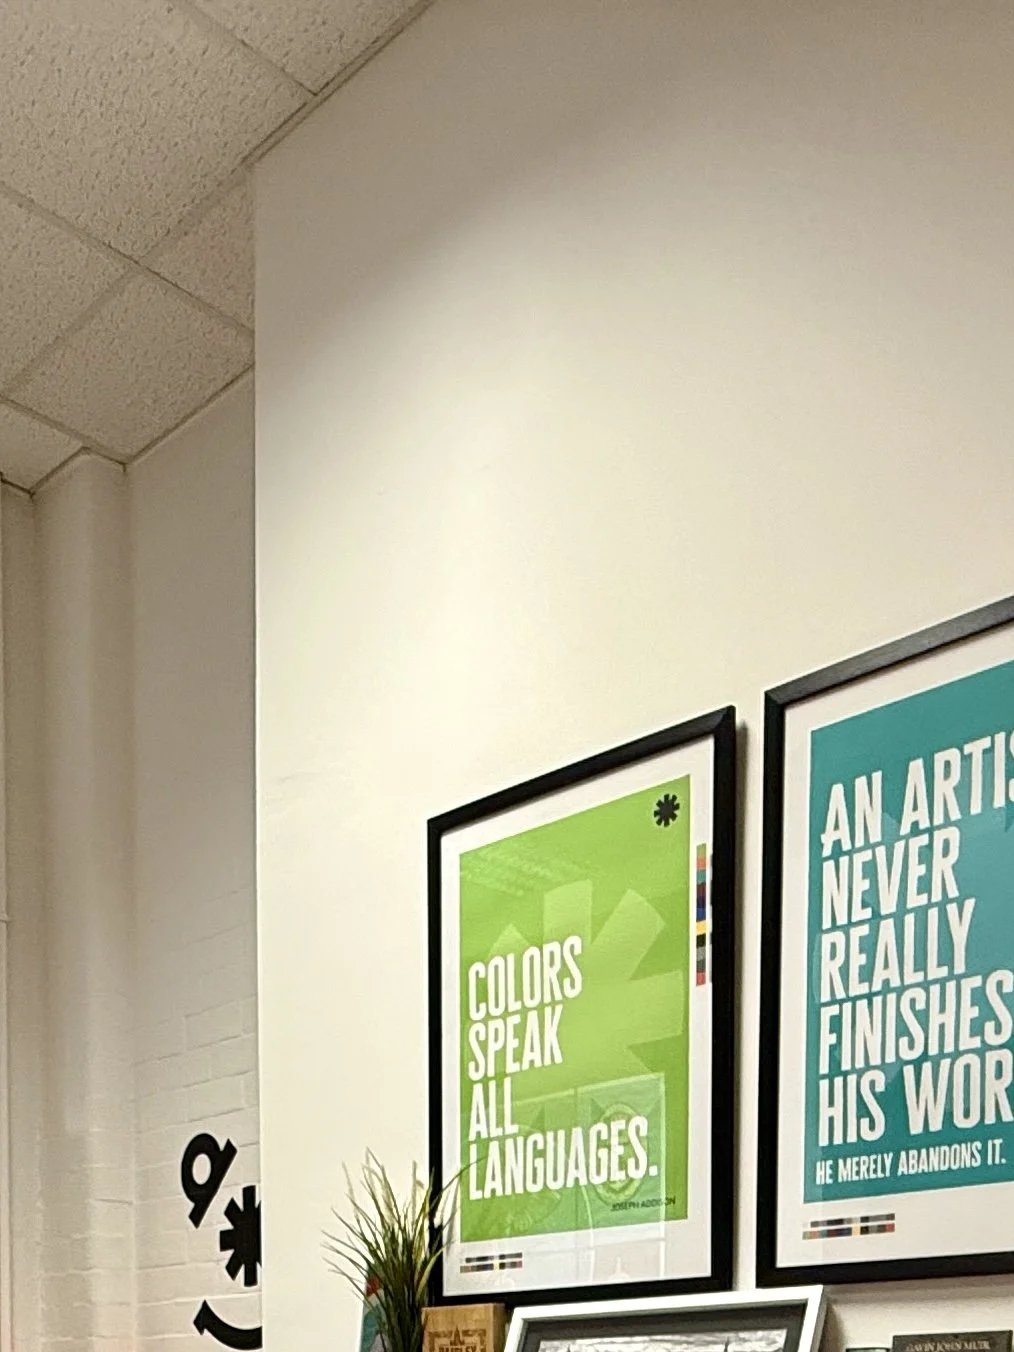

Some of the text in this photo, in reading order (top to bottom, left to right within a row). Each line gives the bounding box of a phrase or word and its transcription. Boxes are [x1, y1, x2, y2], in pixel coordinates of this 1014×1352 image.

[820, 770, 883, 858] AN
[821, 826, 961, 930] NEVER
[468, 935, 583, 1021] COLORS
[820, 897, 976, 1003] REALLY
[468, 1004, 563, 1081] SPEAK
[819, 969, 1014, 1075] FINISHES
[468, 1076, 519, 1141] ALL
[818, 1069, 886, 1147] HIS
[469, 1115, 658, 1200] LANGUAGES.
[815, 1138, 1007, 1185] HE MERELY ABANDONS IT.
